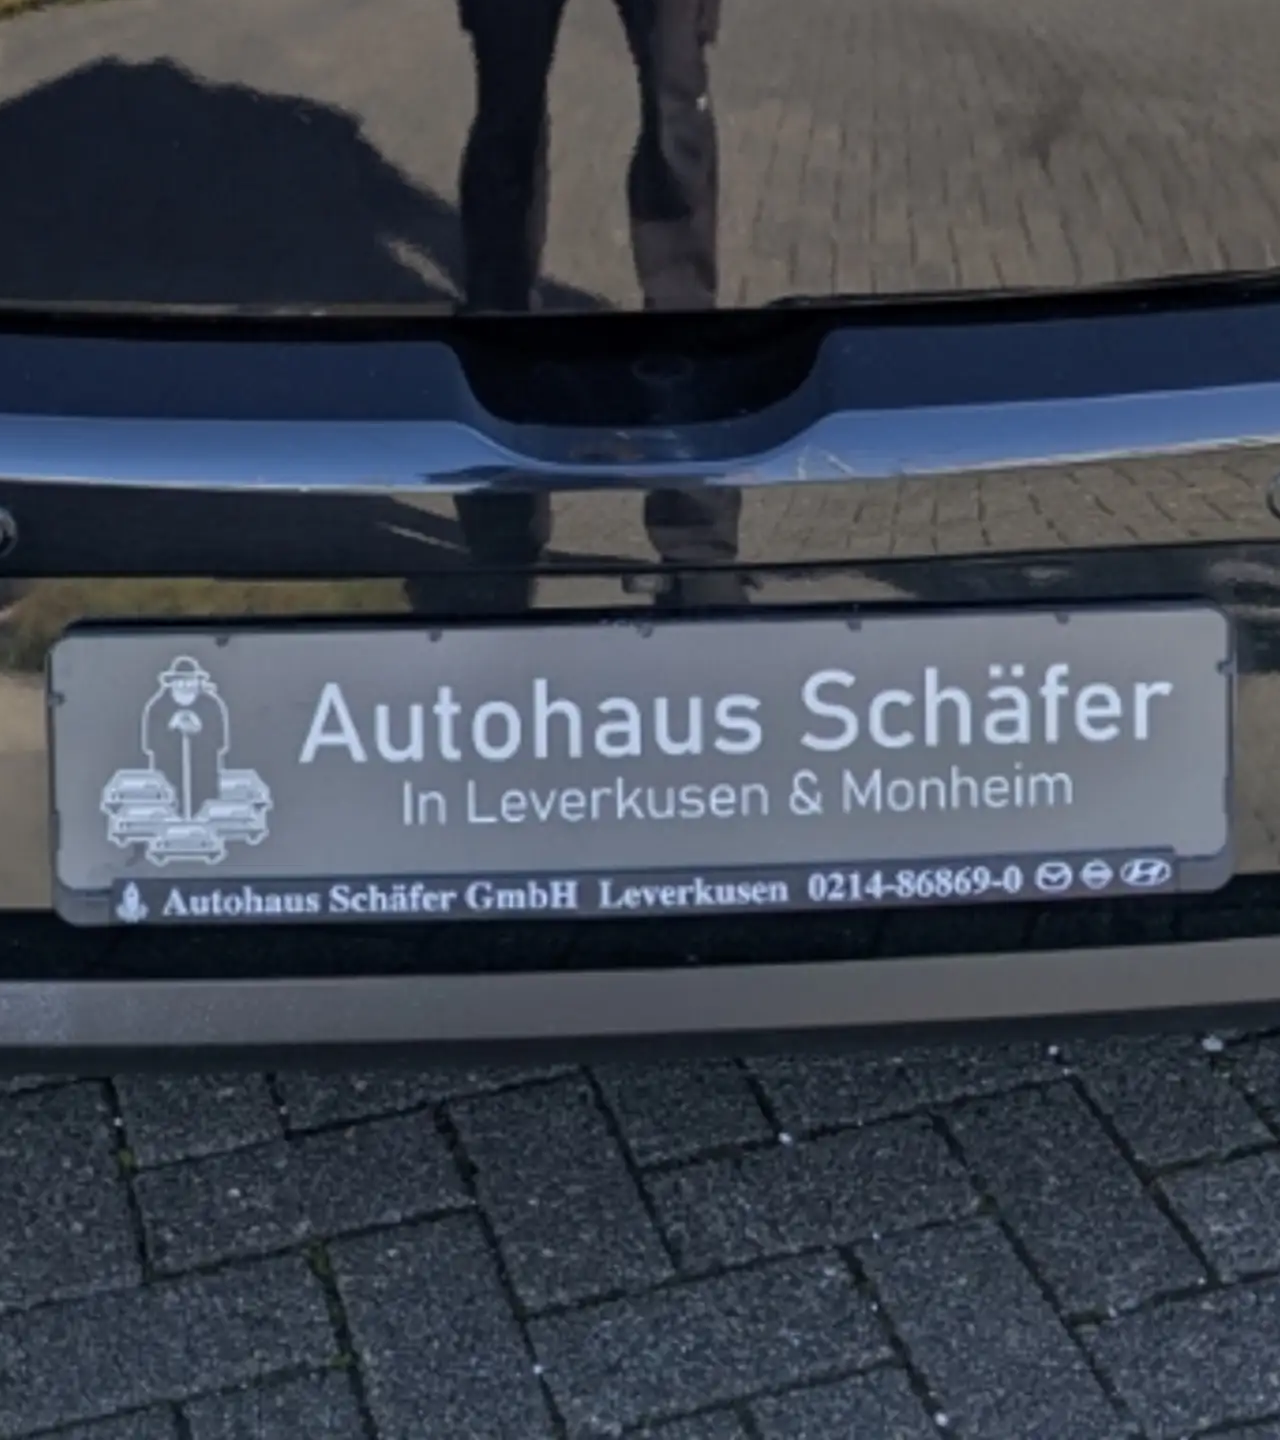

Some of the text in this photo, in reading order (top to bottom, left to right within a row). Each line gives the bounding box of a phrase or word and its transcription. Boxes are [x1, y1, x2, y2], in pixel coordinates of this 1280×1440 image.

[298, 663, 1173, 764] Autohaus Schäfer
[402, 763, 1074, 826] In Leverkusen & Monheim
[162, 865, 1021, 916] Autohaus Schäfer GmbH Leverkusen 0214-86869-0
